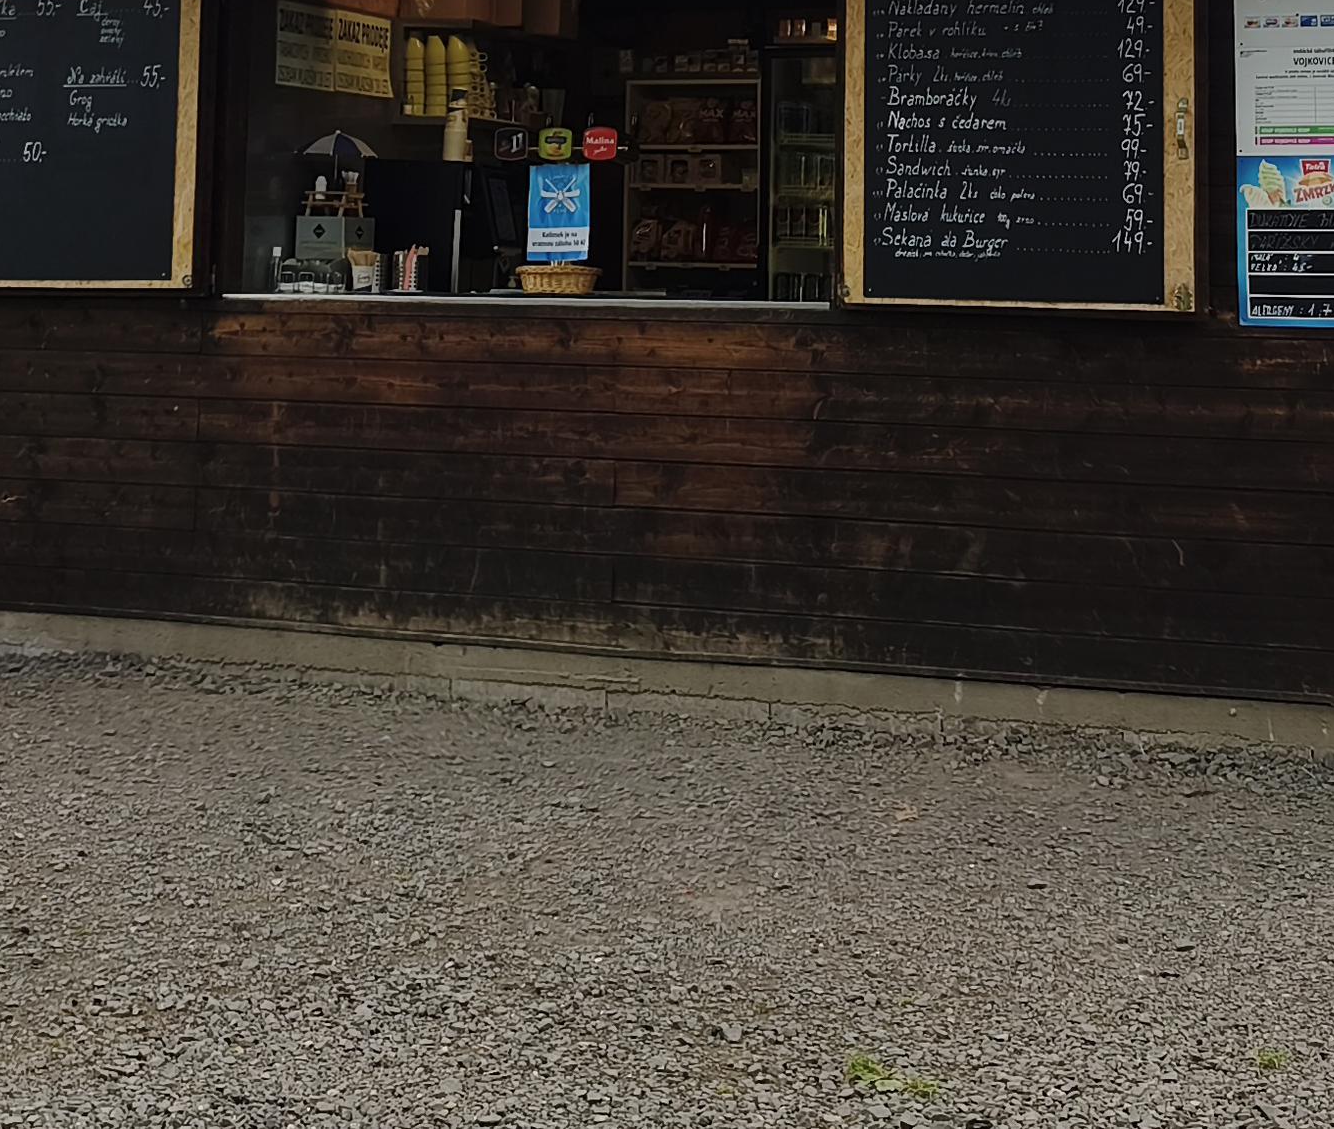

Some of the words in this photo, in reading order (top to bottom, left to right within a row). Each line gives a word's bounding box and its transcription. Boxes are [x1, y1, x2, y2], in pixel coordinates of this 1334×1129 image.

[69, 90, 92, 112] Grog
[886, 85, 978, 111] Bramboráčky
[887, 110, 931, 130] Nachos
[938, 116, 946, 129] s
[951, 112, 1007, 131] čedarem
[586, 137, 614, 145] Malina
[886, 133, 937, 154] Tortilla
[885, 155, 952, 177] Sandwich
[885, 178, 948, 200] Palačinka
[961, 229, 1009, 252] Burger
